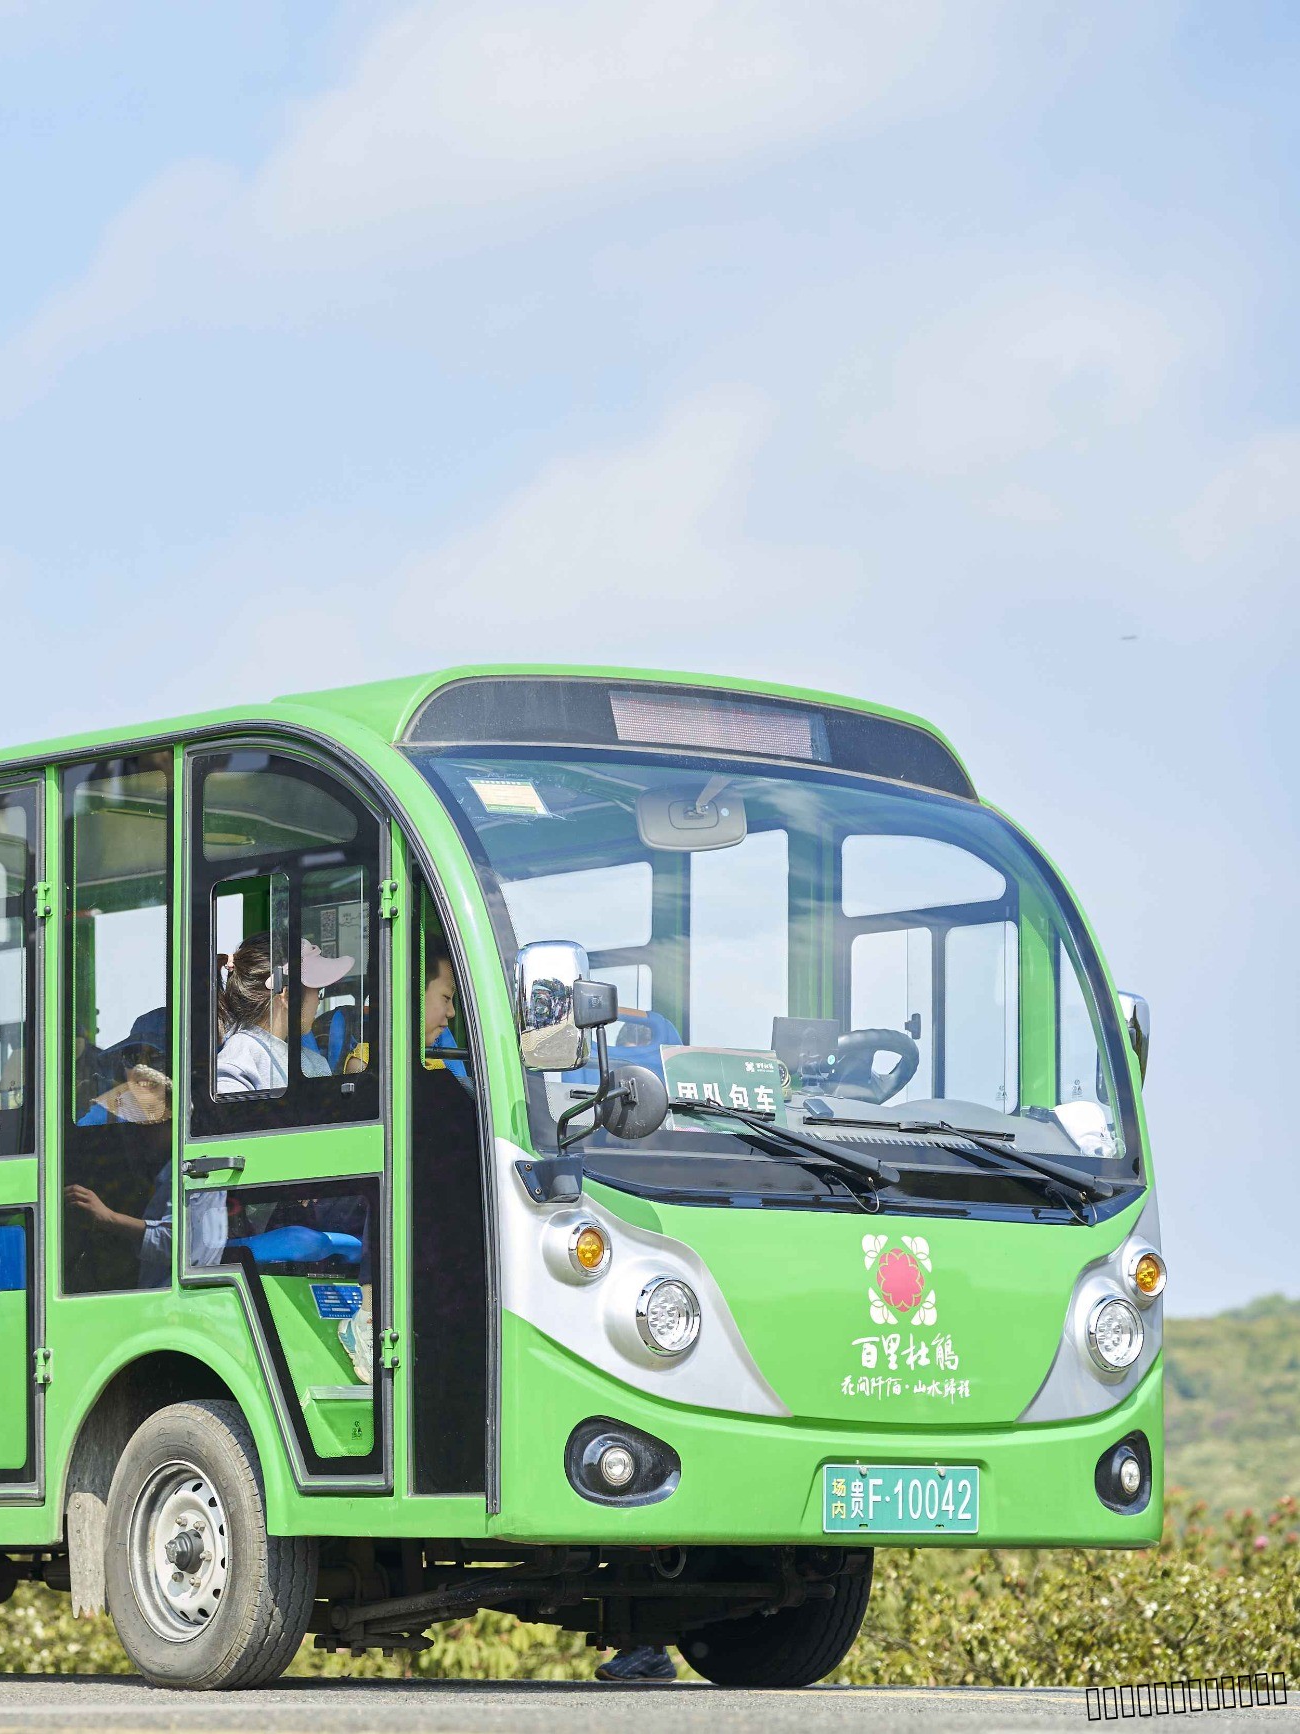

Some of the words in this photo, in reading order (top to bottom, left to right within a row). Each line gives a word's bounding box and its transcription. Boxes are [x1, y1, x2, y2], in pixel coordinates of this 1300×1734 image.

[677, 1082, 776, 1112] 团队包车
[832, 1478, 846, 1519] 场内
